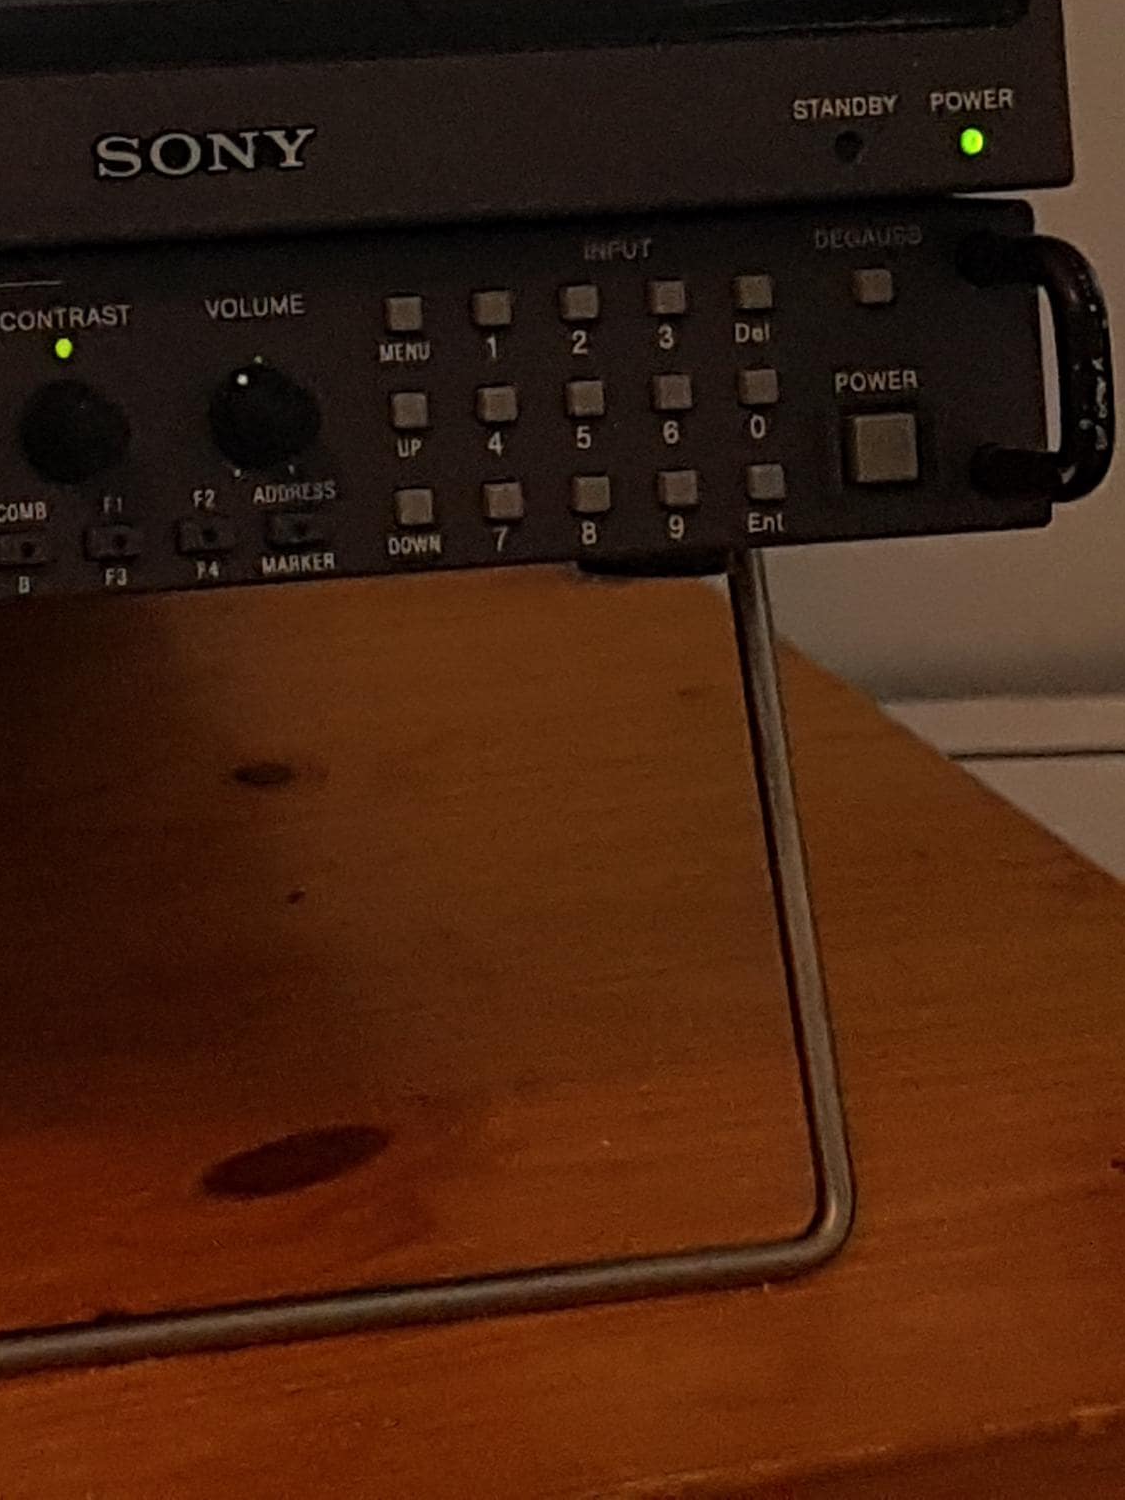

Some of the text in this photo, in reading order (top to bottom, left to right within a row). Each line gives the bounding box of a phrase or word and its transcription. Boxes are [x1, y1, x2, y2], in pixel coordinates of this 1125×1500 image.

[792, 94, 898, 121] STANDBY
[929, 87, 1014, 113] POWER
[96, 127, 317, 178] SONY
[583, 236, 652, 261] INPUT
[814, 224, 923, 250] DEGAUSS
[0, 304, 132, 333] CONTRAST
[205, 294, 305, 320] VOLUME
[572, 329, 589, 356] 2
[658, 324, 675, 350] 3
[734, 322, 771, 344] Del
[379, 341, 431, 363] MENU
[486, 336, 499, 359] 1
[834, 369, 919, 394] POWER
[575, 425, 592, 451] 5
[663, 420, 680, 446] 6
[749, 414, 766, 440] 0
[397, 438, 422, 459] UP
[487, 431, 504, 456] 4
[193, 488, 216, 510] F2
[253, 479, 337, 505] ADDRESS
[103, 496, 124, 514] F1
[581, 520, 597, 546] 8
[668, 514, 685, 540] 9
[746, 510, 784, 534] Ent
[387, 532, 443, 556] DOWN
[492, 526, 508, 551] 7
[195, 560, 221, 580] F4
[260, 552, 336, 576] MARKER
[105, 567, 128, 587] F3
